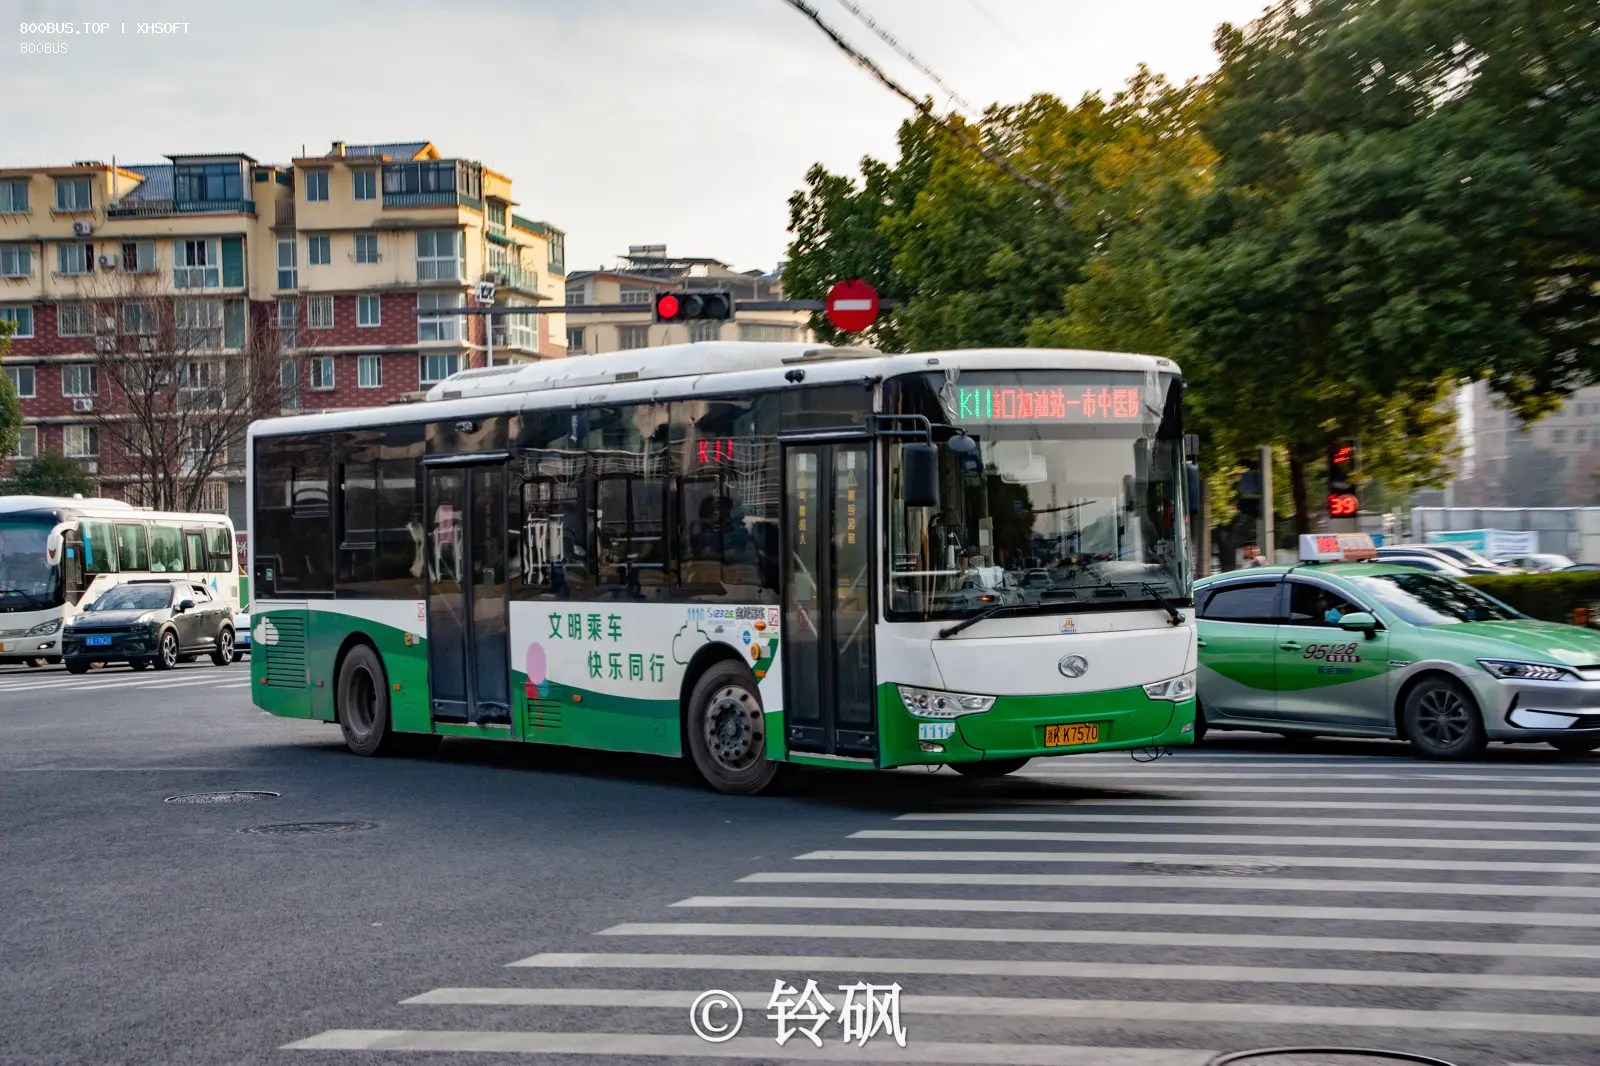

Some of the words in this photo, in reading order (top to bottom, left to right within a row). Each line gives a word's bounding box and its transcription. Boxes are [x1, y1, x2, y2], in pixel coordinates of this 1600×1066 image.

[960, 388, 992, 419] K11
[699, 439, 733, 463] K11
[548, 612, 623, 642] 文明乘车
[1303, 642, 1358, 660] 95128
[587, 651, 665, 683] 快乐同行
